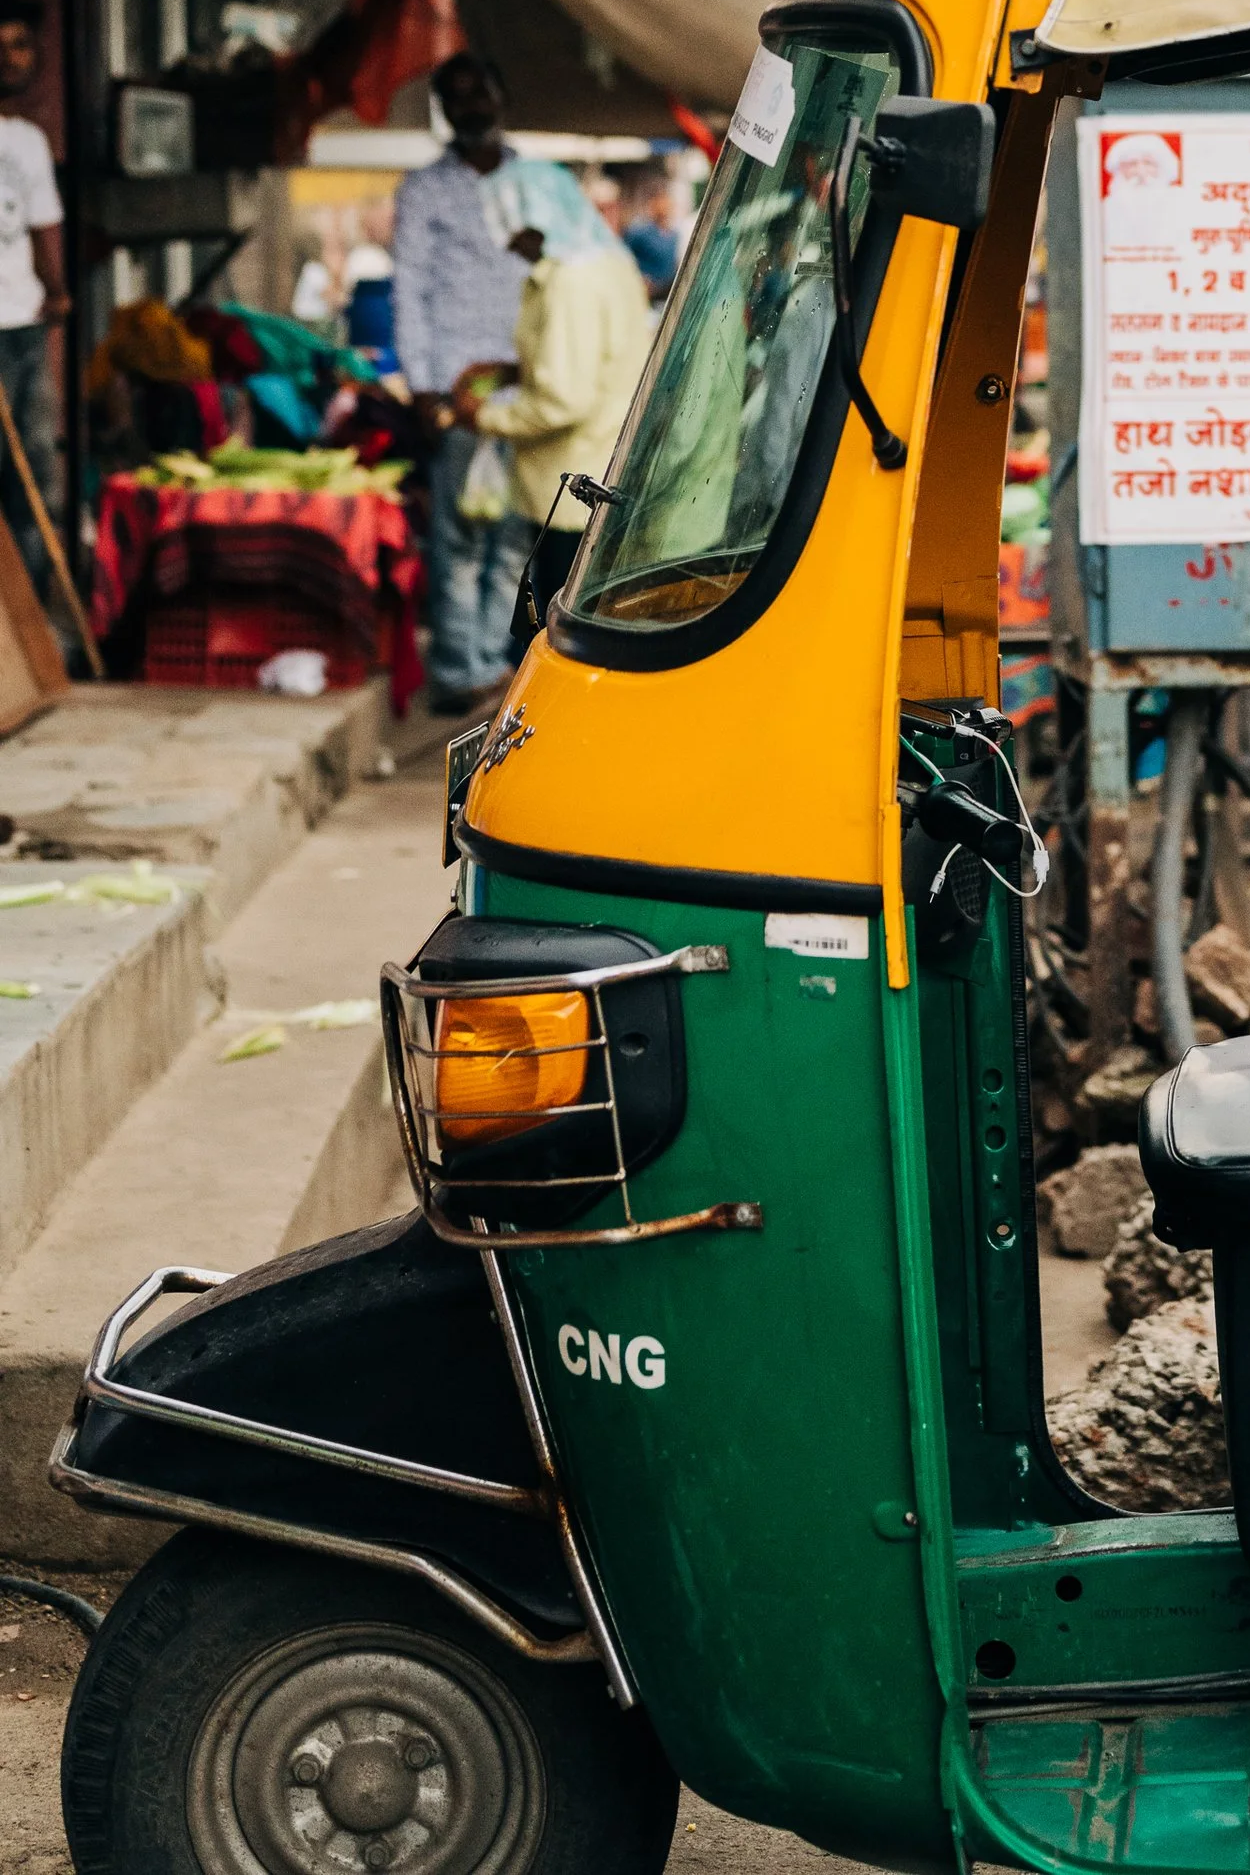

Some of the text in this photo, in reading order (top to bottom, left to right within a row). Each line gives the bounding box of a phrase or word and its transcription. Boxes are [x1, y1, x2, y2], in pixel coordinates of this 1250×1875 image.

[1202, 269, 1219, 293] 2
[1113, 421, 1175, 454] हाथ
[1112, 457, 1178, 498] तजो
[558, 1324, 666, 1390] CNG
